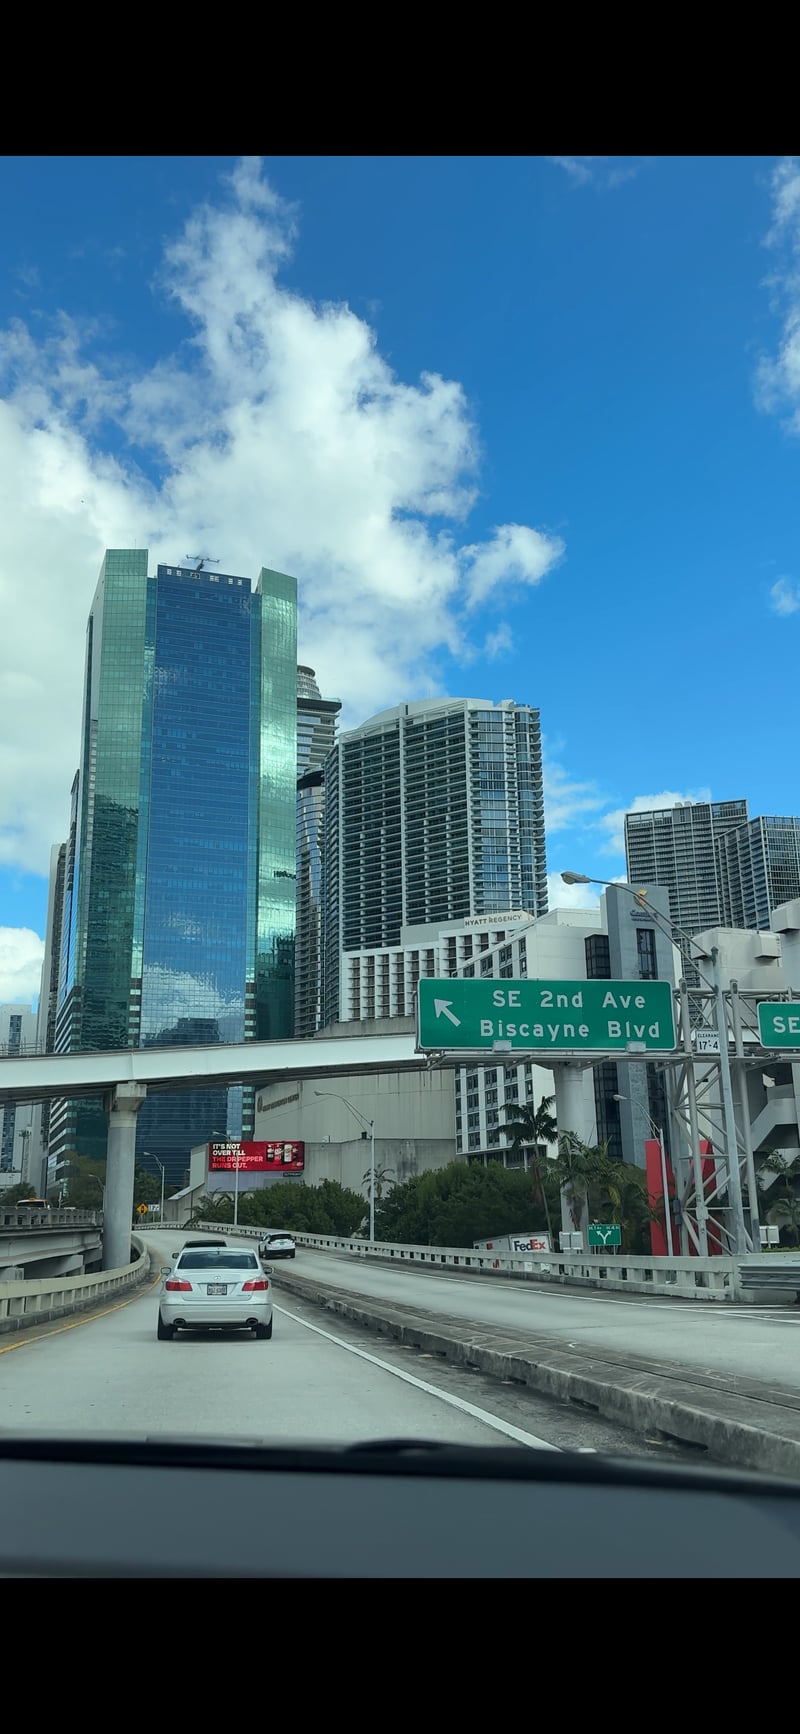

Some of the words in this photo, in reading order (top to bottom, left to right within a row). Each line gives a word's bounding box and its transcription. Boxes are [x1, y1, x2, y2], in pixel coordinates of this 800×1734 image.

[465, 918, 487, 926] HYATT
[488, 914, 522, 924] REGENCY
[492, 990, 521, 1008] SE
[540, 990, 583, 1009] 2nd
[602, 991, 646, 1009] Ave
[480, 1019, 590, 1042] Biscayne
[607, 1020, 660, 1039] Blvd
[772, 1016, 800, 1034] SE
[513, 1238, 546, 1252] FedEx
